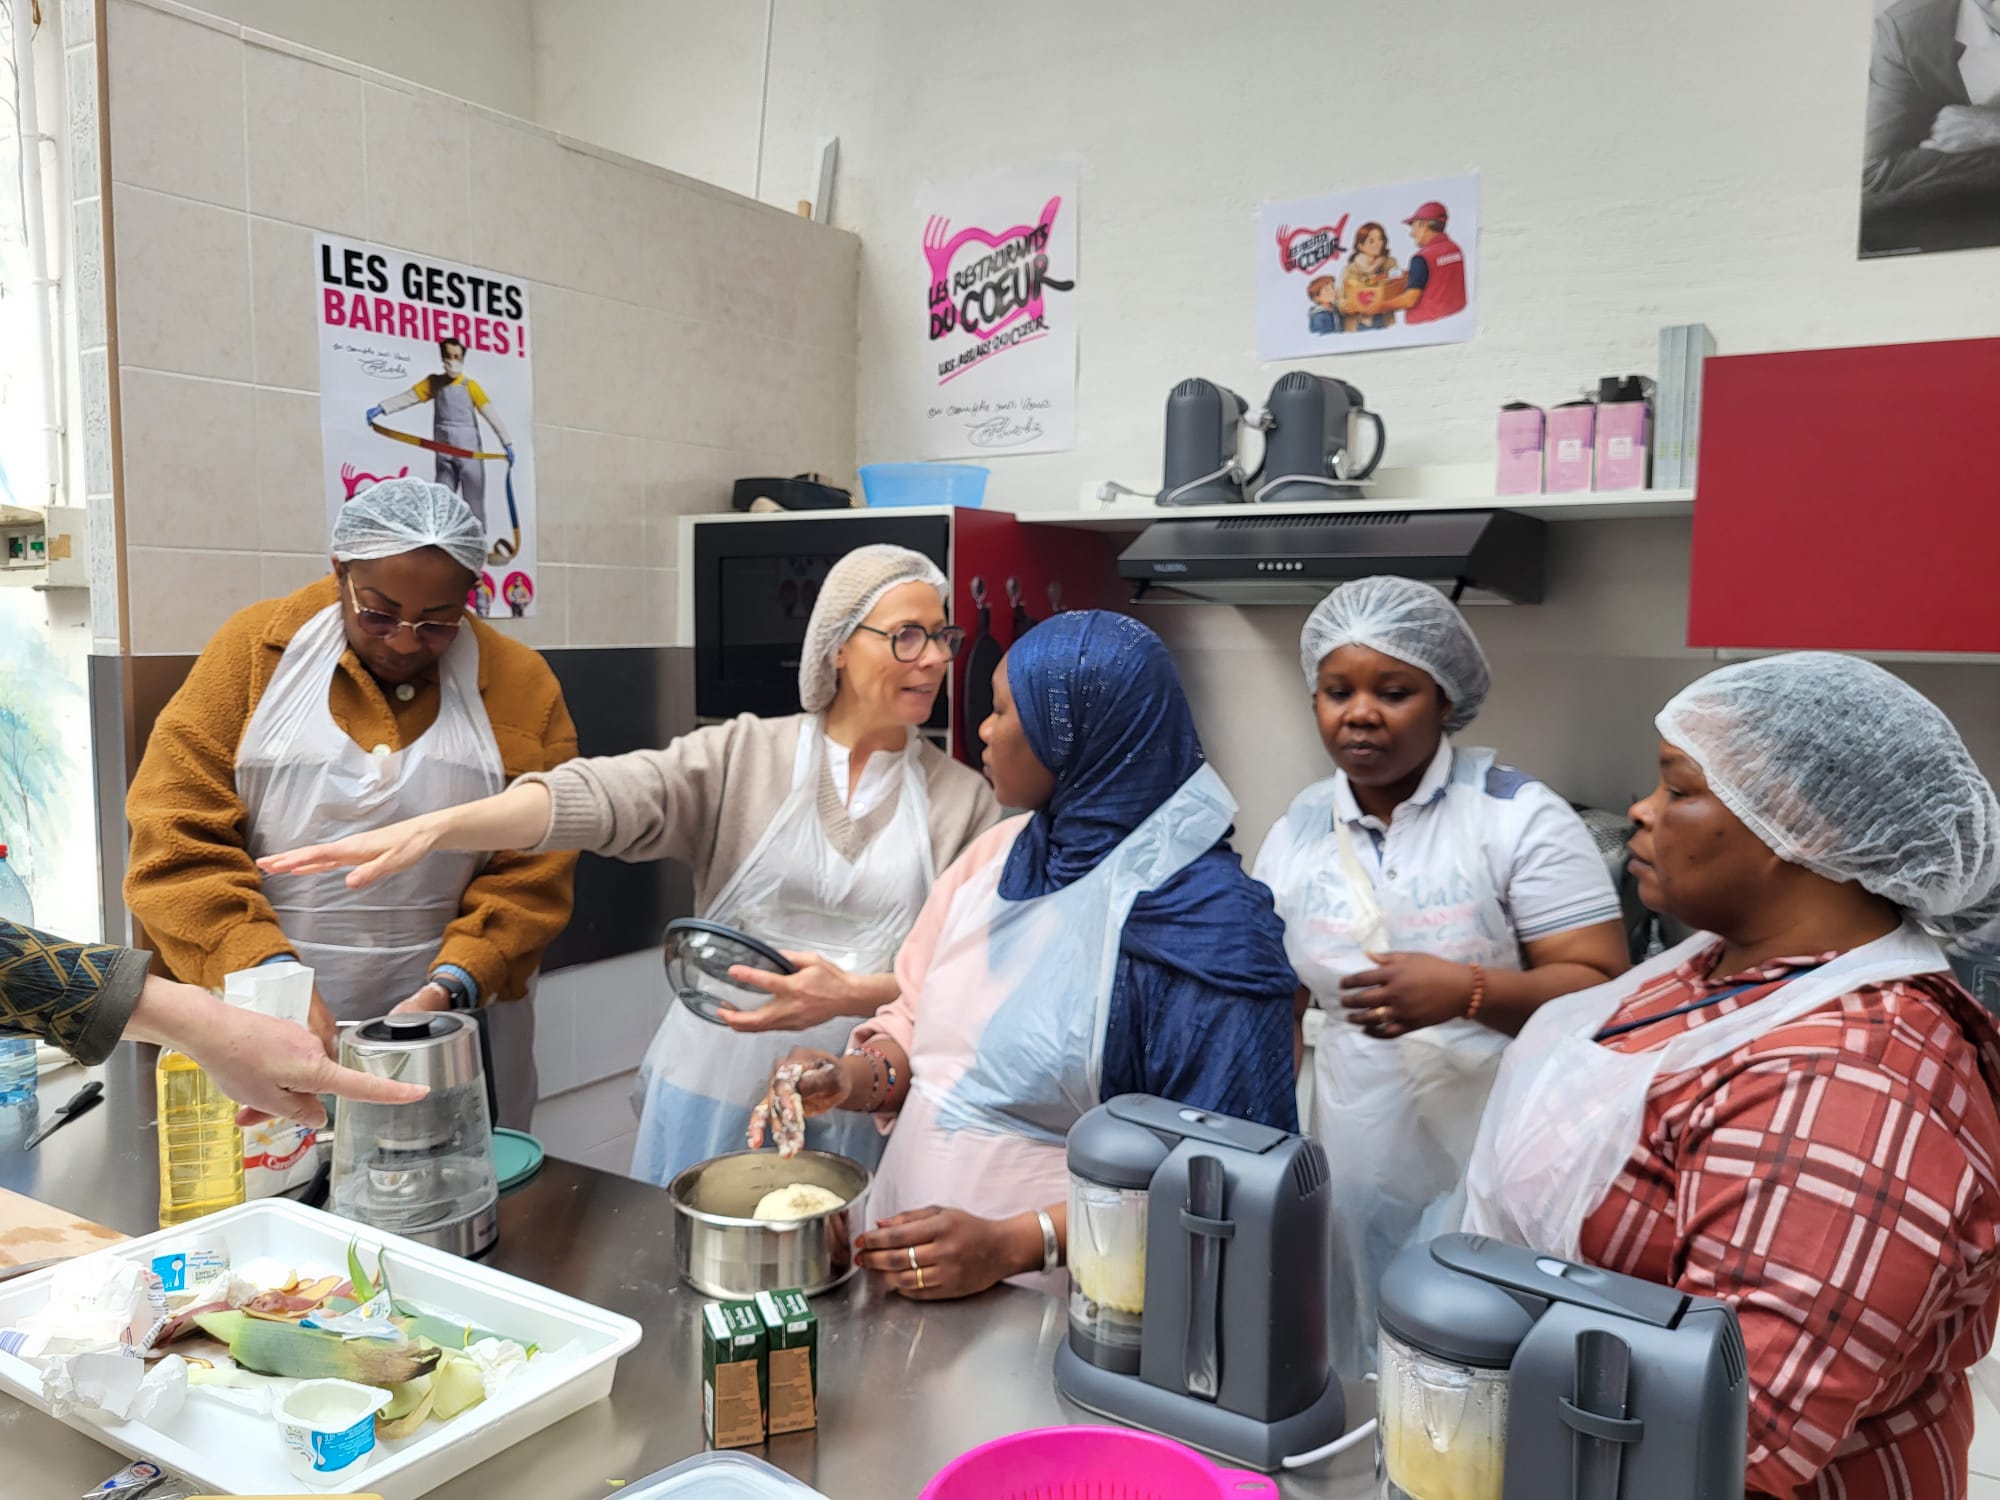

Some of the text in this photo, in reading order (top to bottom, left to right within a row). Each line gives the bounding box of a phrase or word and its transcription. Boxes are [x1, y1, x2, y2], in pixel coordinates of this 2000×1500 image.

[321, 244, 523, 320] LES GESTES
[929, 223, 1049, 309] LES RESTAURANTS
[930, 303, 956, 340] DU
